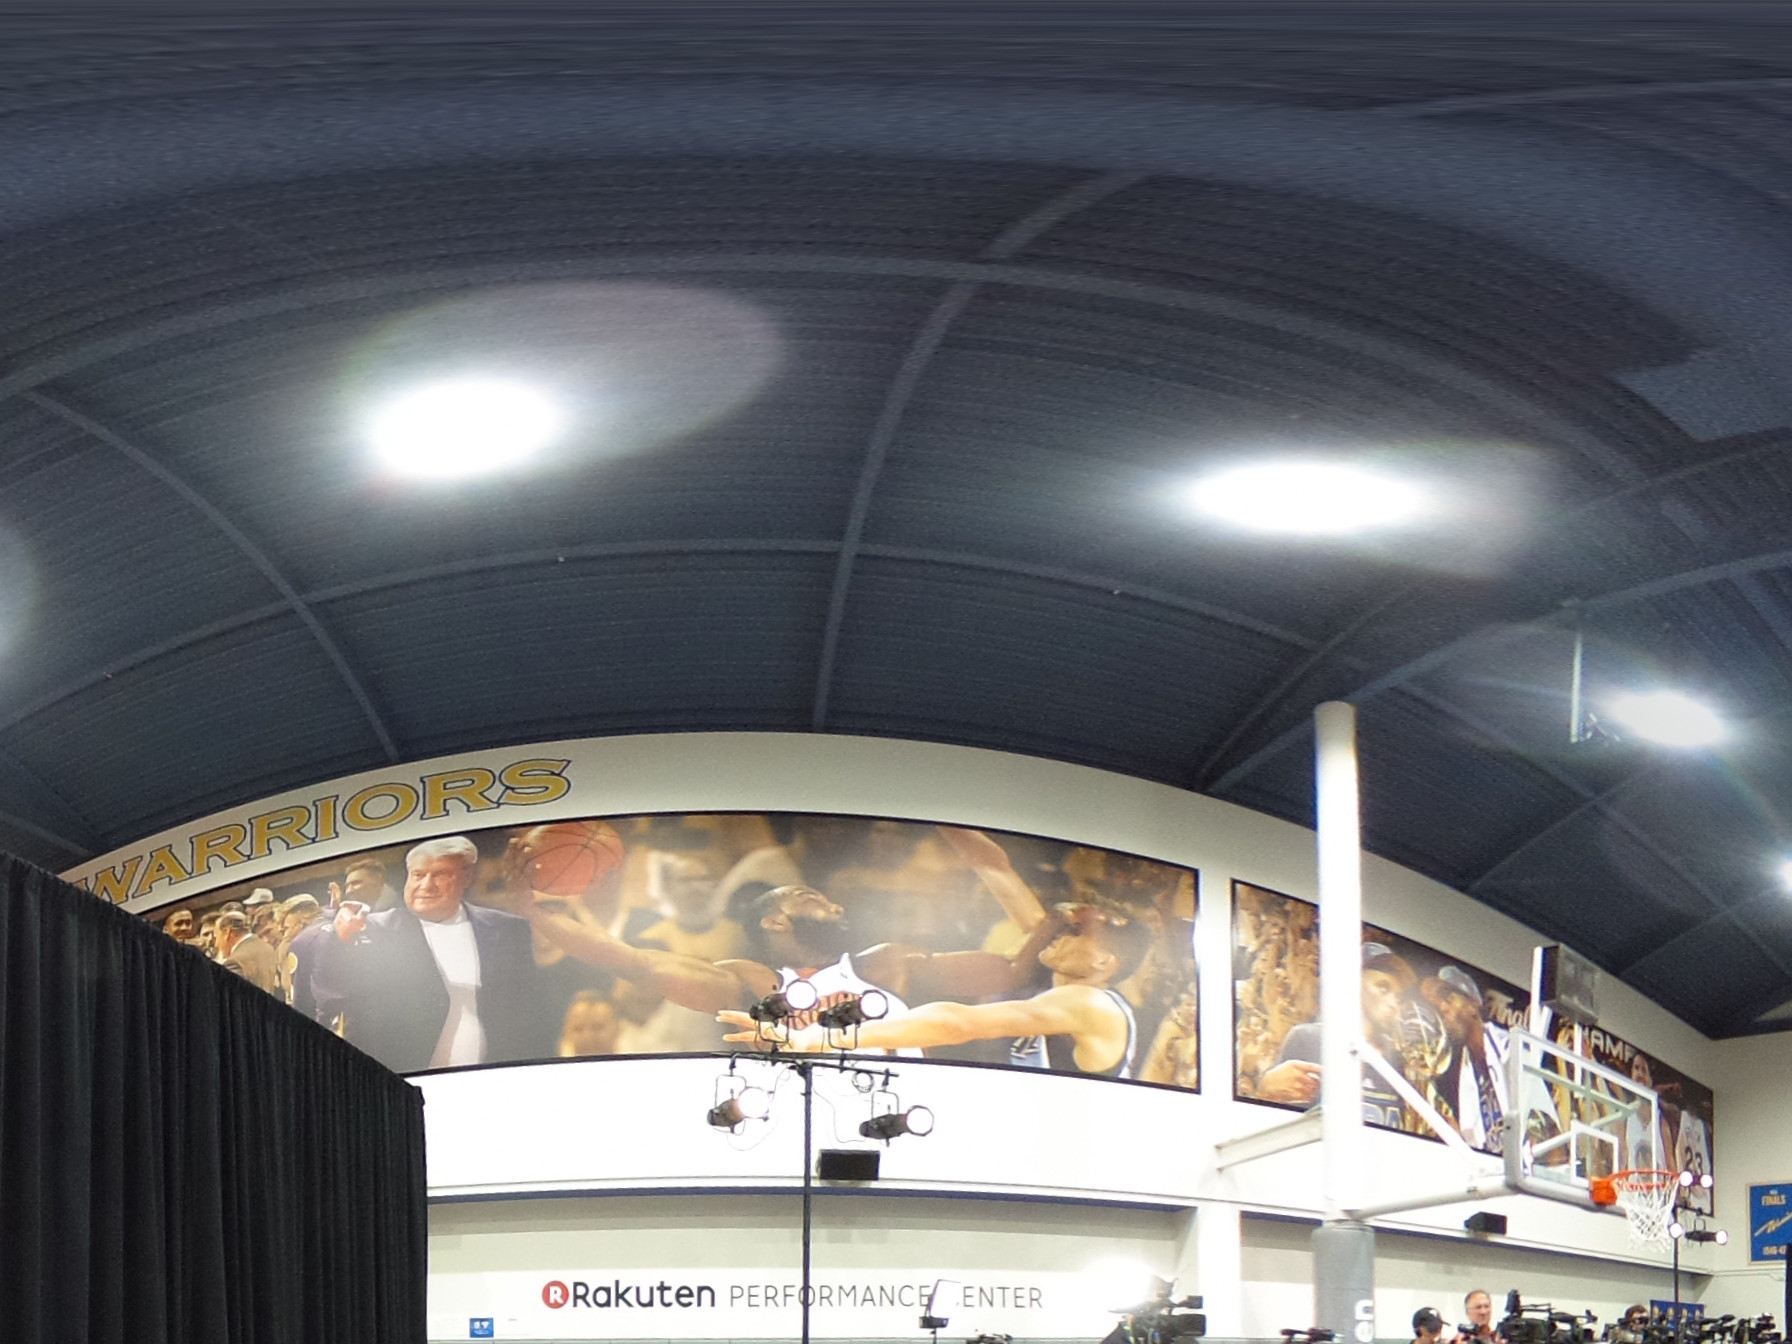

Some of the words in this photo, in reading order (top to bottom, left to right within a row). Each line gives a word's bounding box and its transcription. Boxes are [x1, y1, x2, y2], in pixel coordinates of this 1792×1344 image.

[75, 758, 573, 907] WARRIORS
[1762, 1194, 1786, 1206] FINALS
[572, 1280, 716, 1308] Rakuten
[730, 1285, 931, 1308] PERFORMANCE
